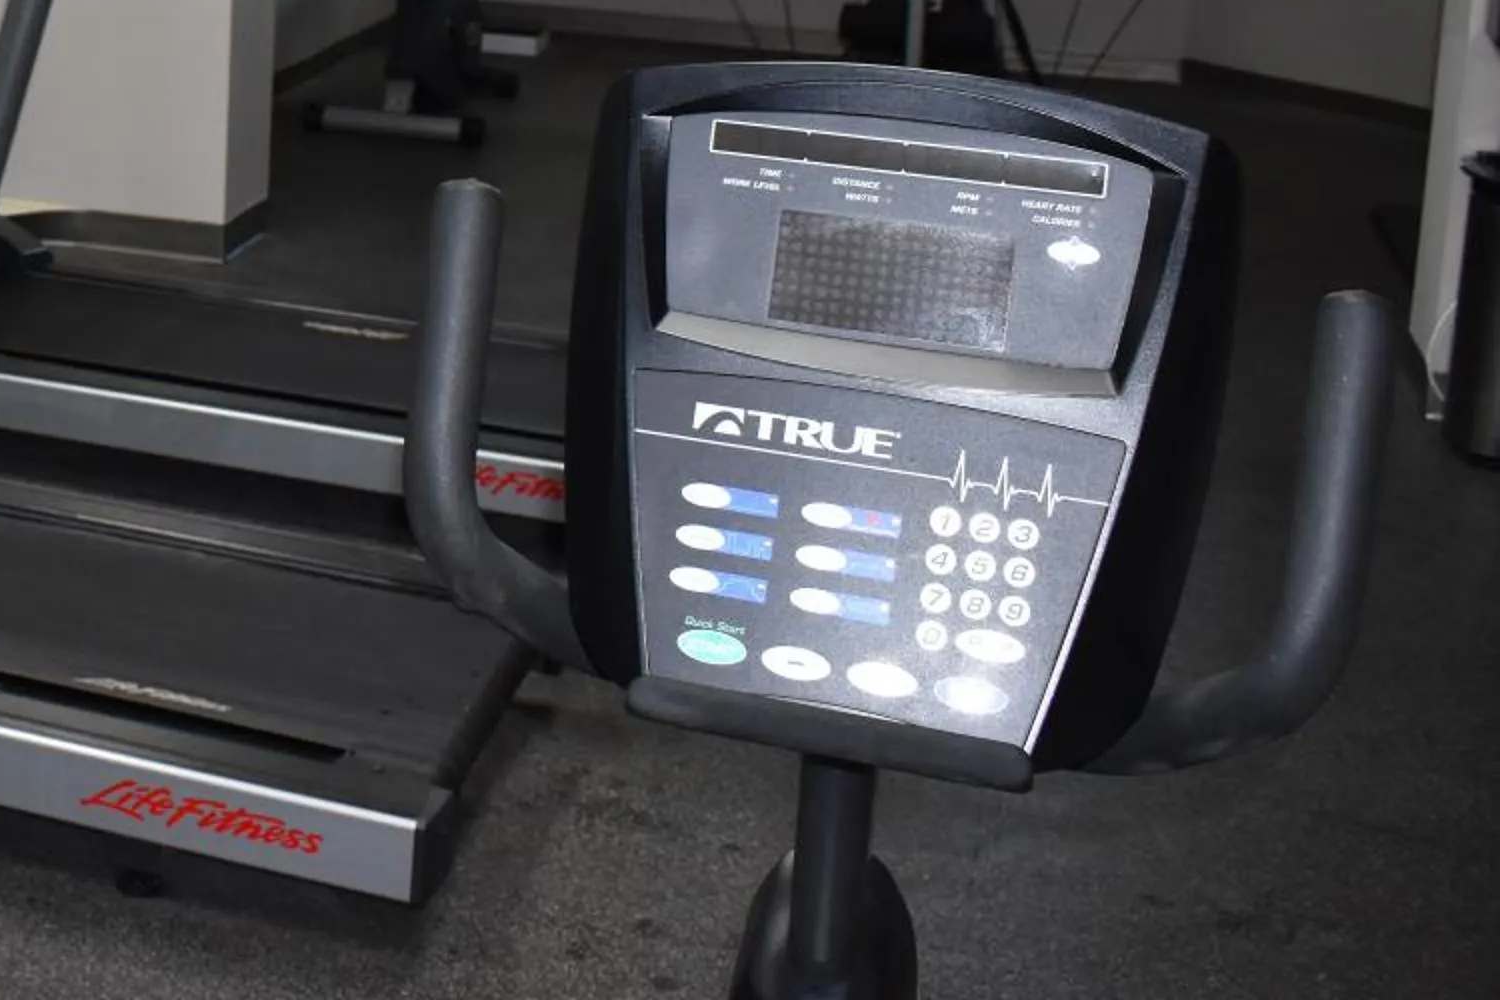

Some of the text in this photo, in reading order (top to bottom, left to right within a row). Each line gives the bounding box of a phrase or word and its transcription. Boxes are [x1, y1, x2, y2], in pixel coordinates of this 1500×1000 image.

[832, 177, 881, 191] DISTANCE
[746, 409, 900, 459] TRUE
[974, 519, 994, 538] 2
[1014, 525, 1033, 543] 3
[931, 551, 1029, 582] 4 5 6
[928, 588, 1024, 621] 7 8 9
[716, 621, 746, 635] Start
[165, 796, 325, 855] Fitness
